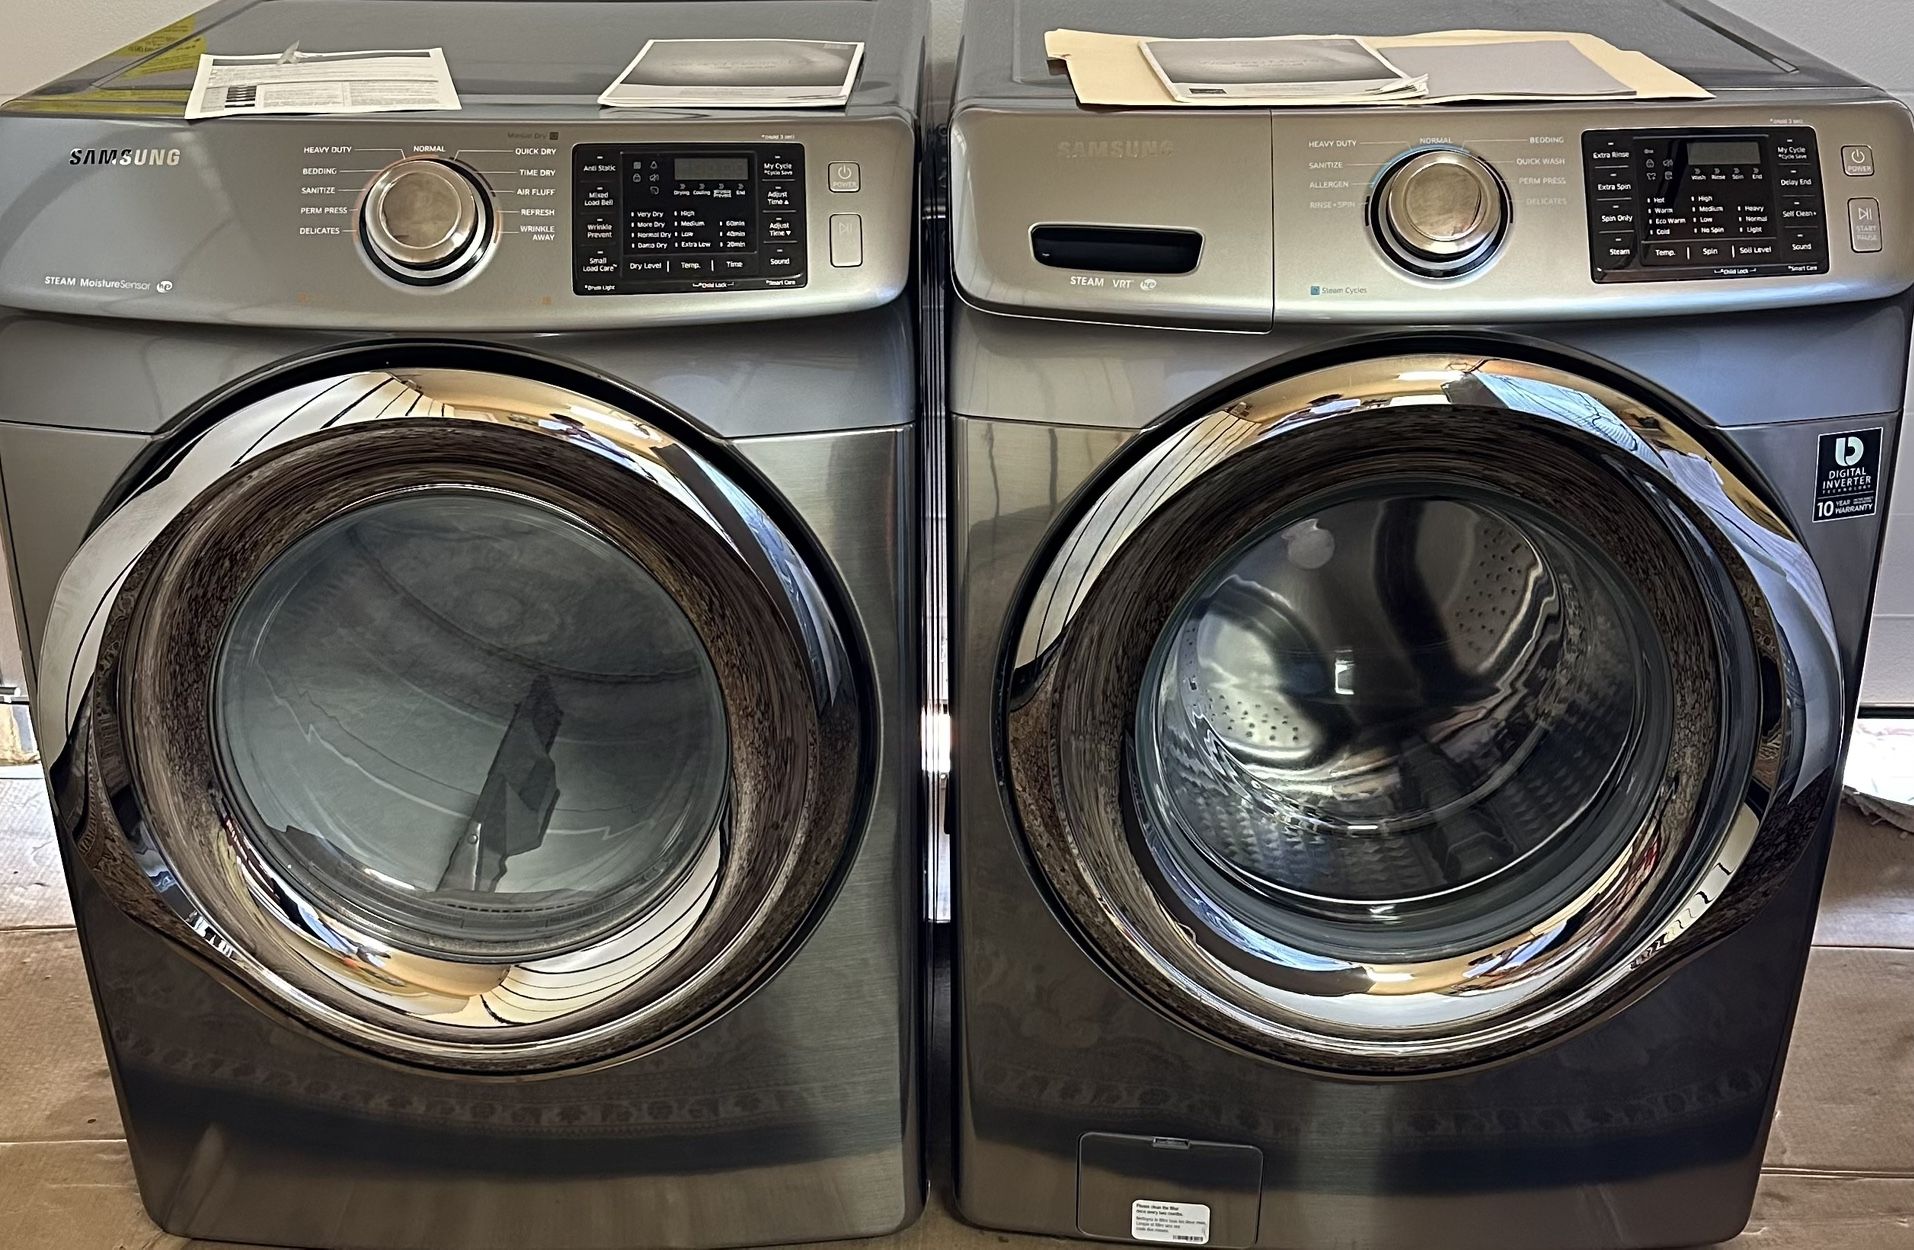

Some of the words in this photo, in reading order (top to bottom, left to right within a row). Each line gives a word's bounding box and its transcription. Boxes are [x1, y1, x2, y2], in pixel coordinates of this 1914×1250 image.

[1308, 140, 1334, 148] HEAVY
[1336, 139, 1357, 147] DUTY
[1419, 136, 1453, 144] NORMAL
[1529, 136, 1564, 144] BEDDING
[515, 147, 539, 155] QUICK
[540, 147, 557, 155] DRY
[1057, 140, 1174, 158] SAMSUNG
[1777, 146, 1788, 154] My
[1789, 146, 1806, 154] Cycle
[69, 148, 181, 166] SAMSUNG
[763, 162, 774, 170] My
[775, 162, 792, 170] Cycle
[1309, 181, 1349, 189] ALLERGEN
[1616, 183, 1631, 191] Spin
[516, 188, 530, 196] AIR
[767, 191, 788, 199] Adjust
[1617, 214, 1633, 222] Only
[1782, 210, 1794, 218] Self
[769, 222, 789, 230] Adjust
[299, 227, 340, 235] DELICATES
[1655, 249, 1676, 257] Temp.
[629, 262, 642, 270] Dry
[681, 262, 701, 270] Temp.
[44, 276, 76, 285] STEAM
[1070, 276, 1104, 286] STEAM
[1321, 286, 1343, 294] Steam
[1345, 286, 1367, 295] Cycles
[1828, 466, 1867, 480] DIGITAL
[1822, 475, 1871, 489] INVERTER
[1836, 499, 1851, 507] YEAR
[1816, 500, 1834, 517] 10
[1835, 503, 1873, 514] WARRANTY
